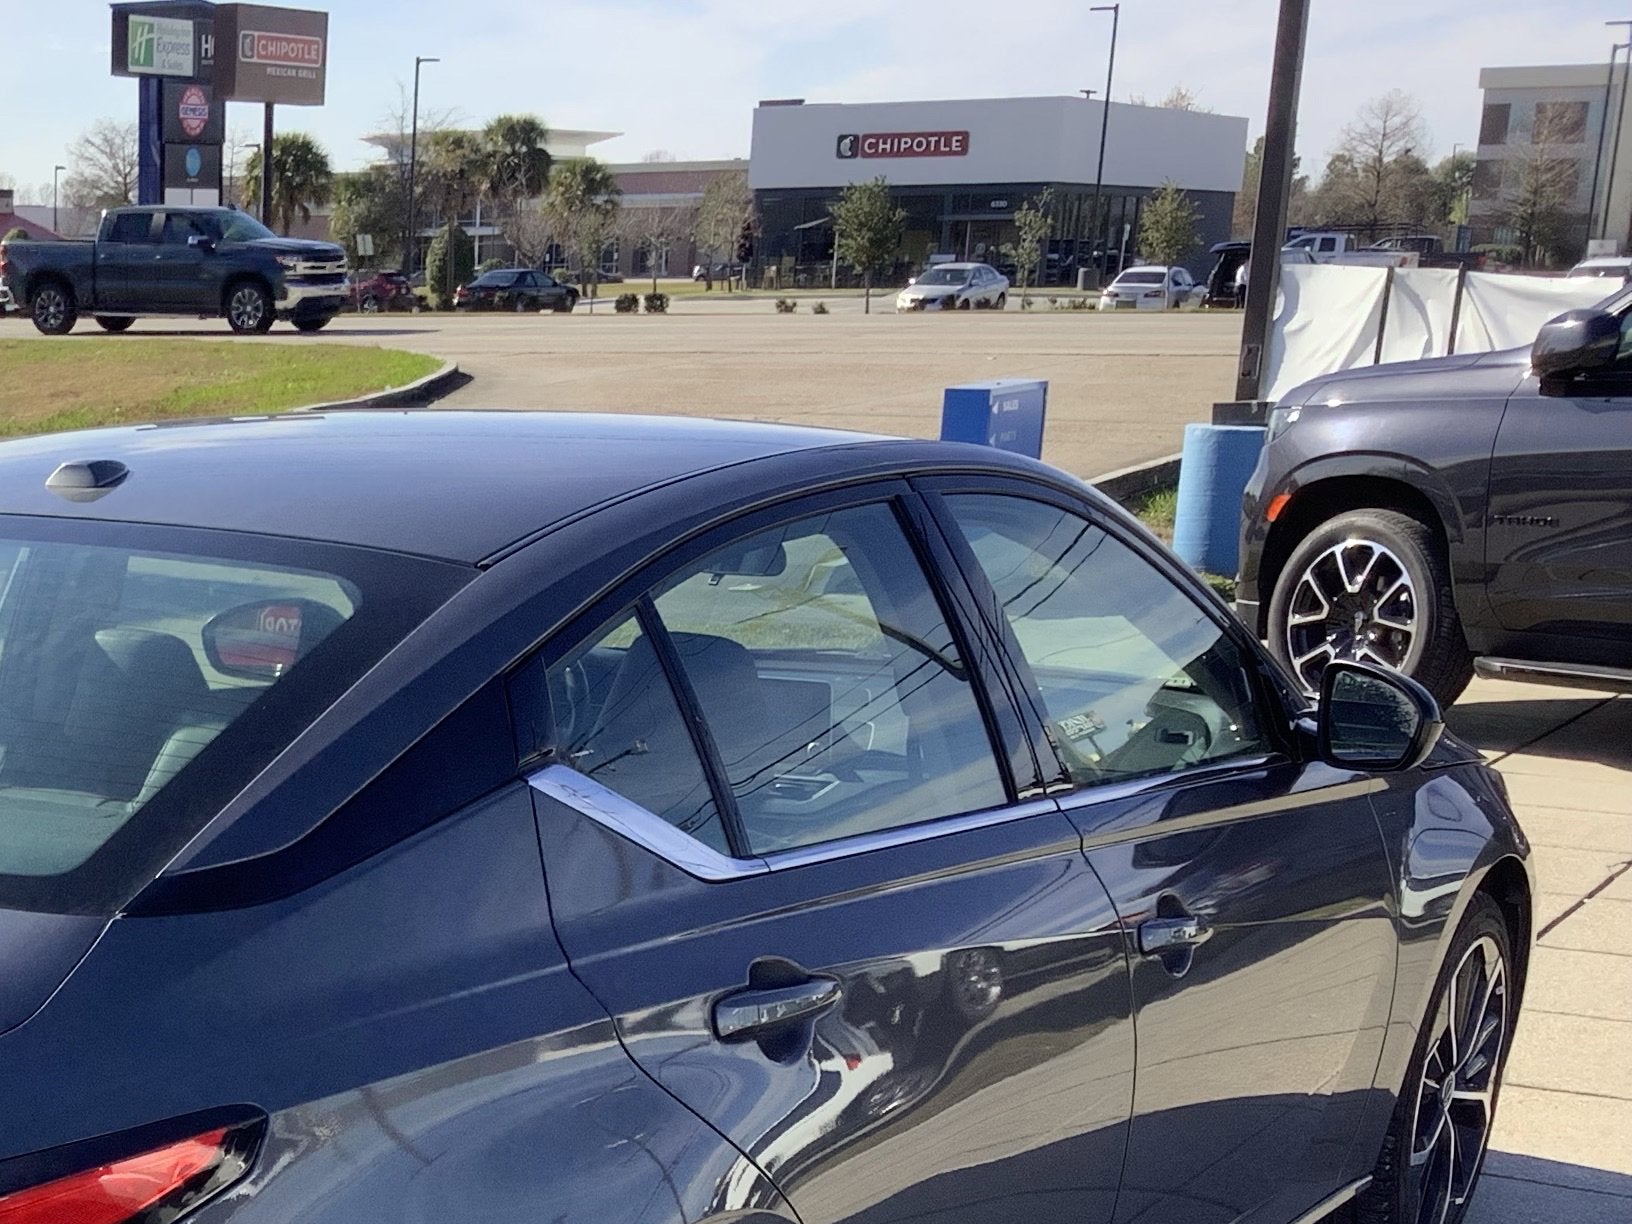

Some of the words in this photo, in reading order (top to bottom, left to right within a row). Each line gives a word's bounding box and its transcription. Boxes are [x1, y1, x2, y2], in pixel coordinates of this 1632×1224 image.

[258, 40, 318, 60] CHIPOTLE
[267, 67, 296, 77] MEXICAN
[864, 135, 964, 154] CHIPOTLE
